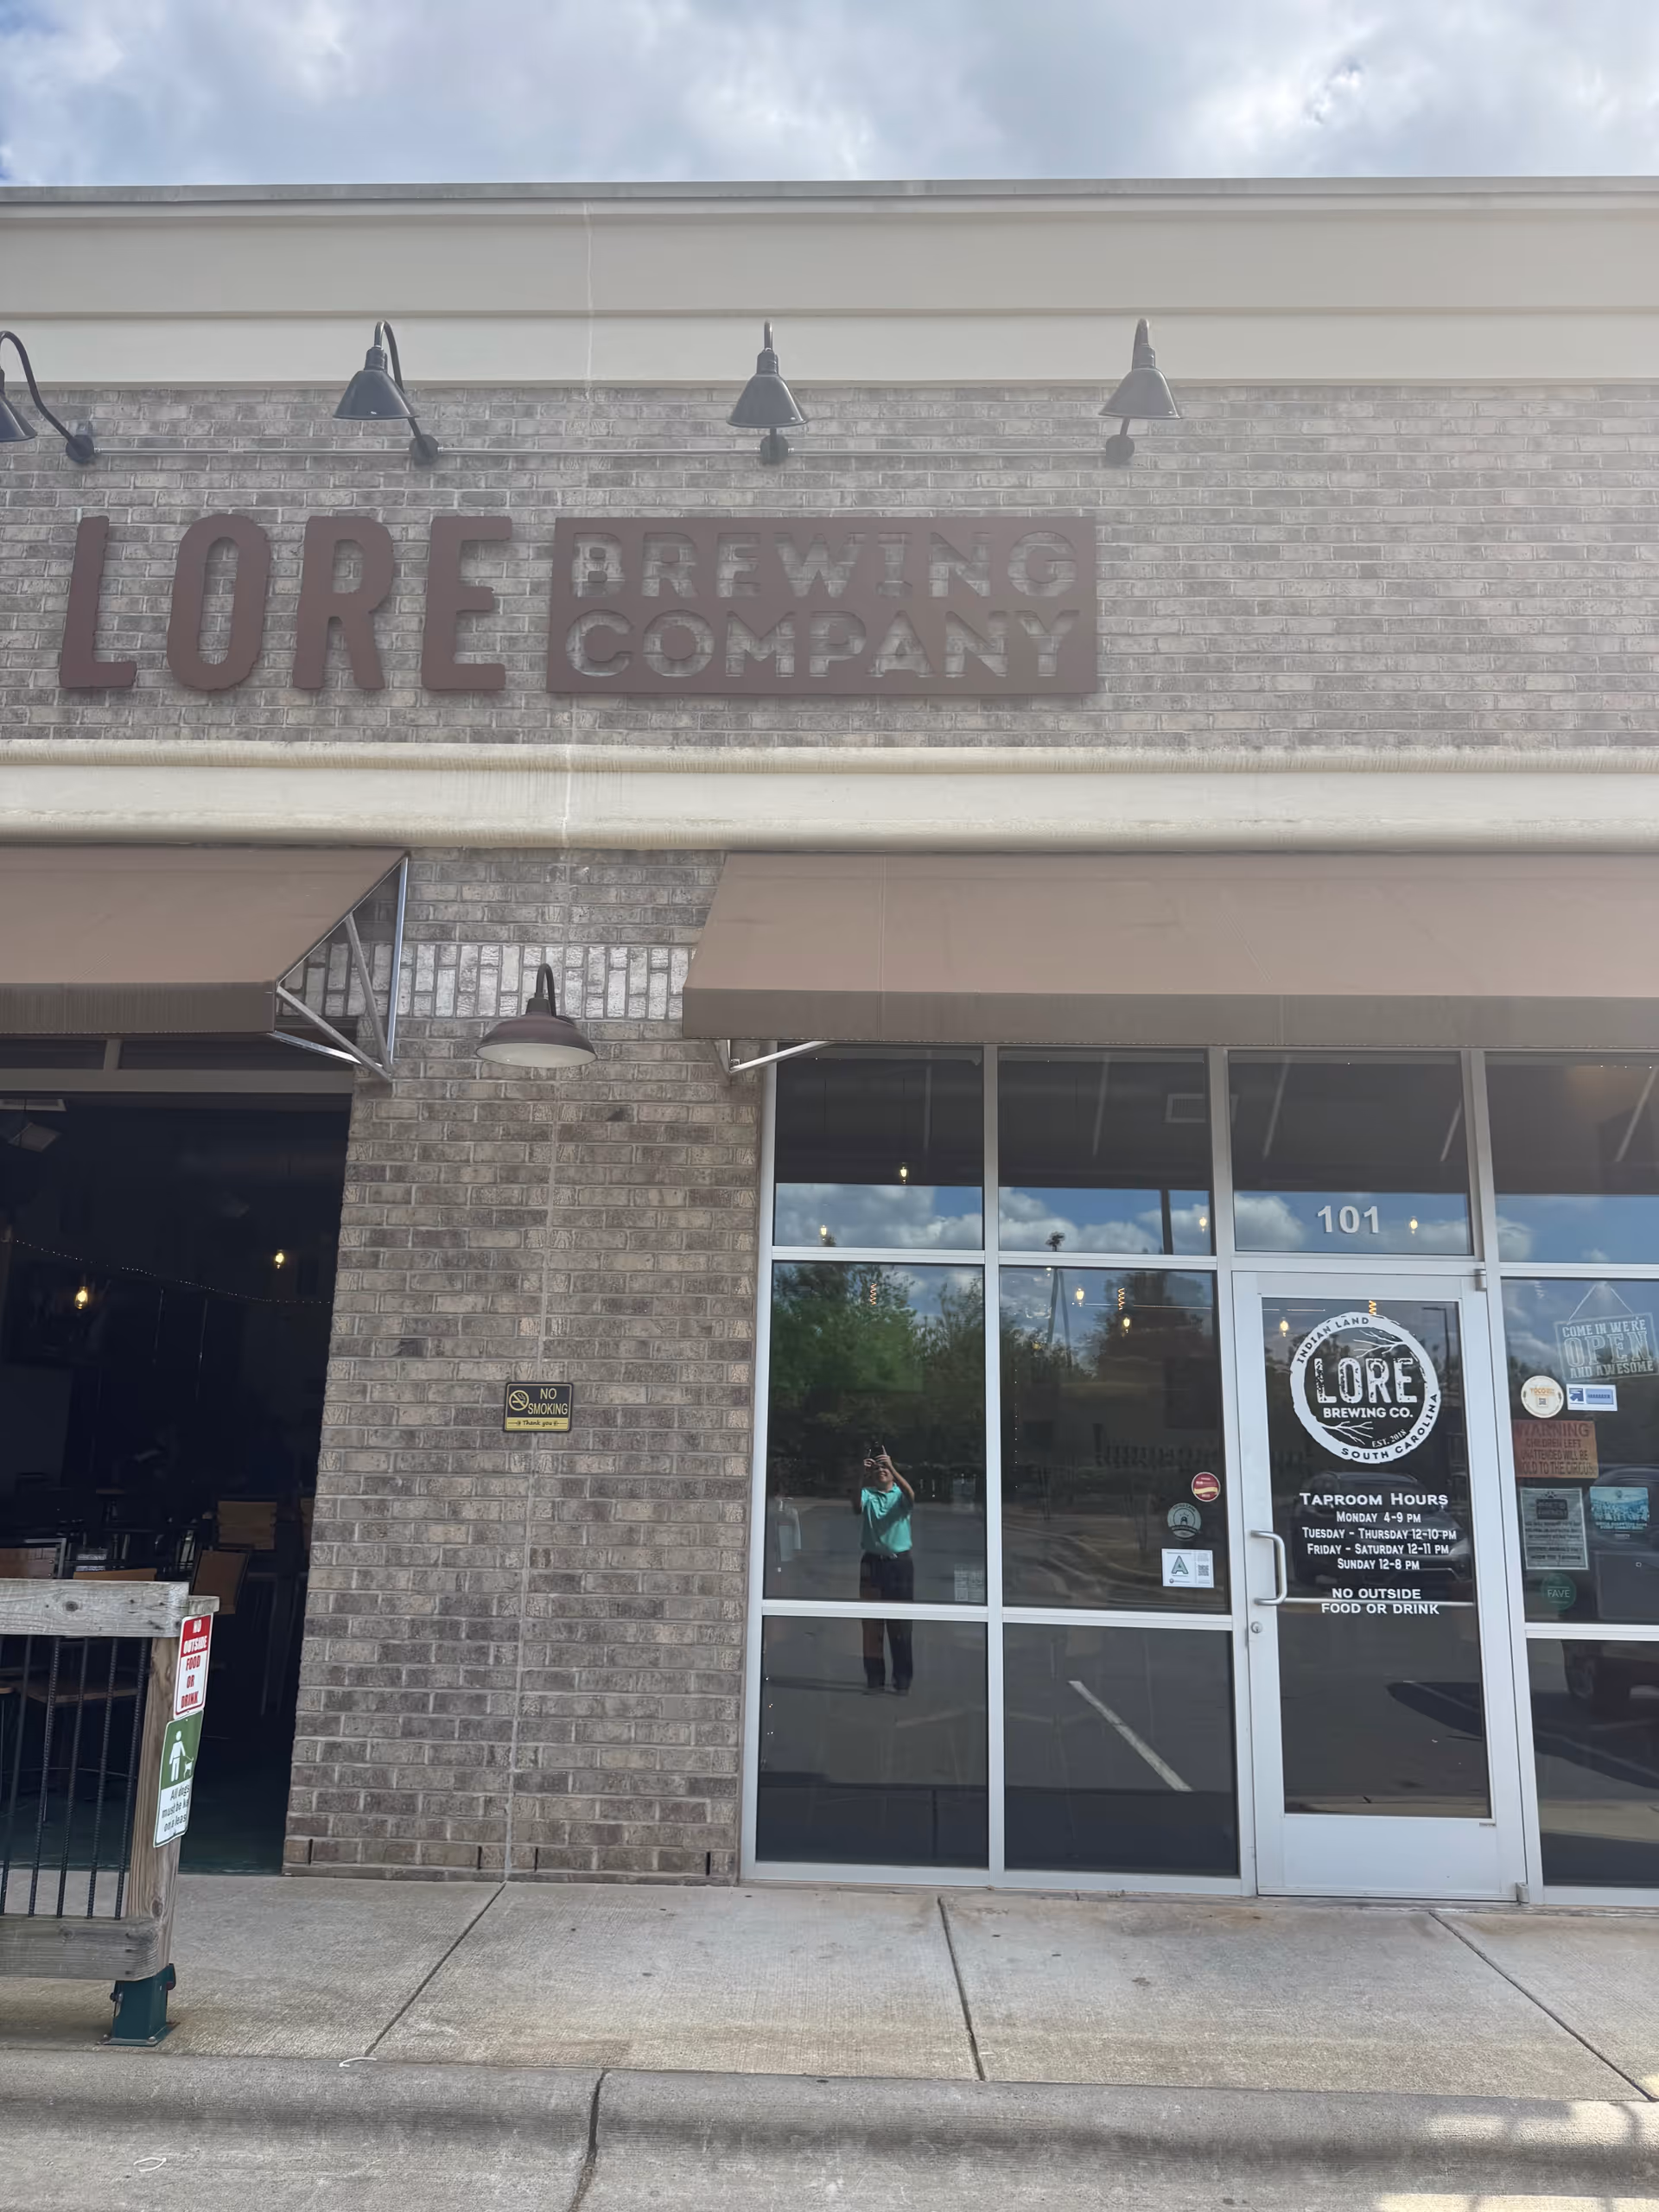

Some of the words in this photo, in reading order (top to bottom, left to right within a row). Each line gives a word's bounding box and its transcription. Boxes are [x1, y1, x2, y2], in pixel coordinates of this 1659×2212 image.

[570, 531, 1078, 599] BREWING
[59, 513, 512, 690] LORE
[564, 608, 1081, 678] COMPANY
[1317, 1205, 1379, 1233] 101
[1562, 1325, 1592, 1338] COME
[1595, 1323, 1606, 1334] IN
[1296, 1325, 1332, 1363] INDIAN
[1335, 1317, 1369, 1328] LAND
[1564, 1331, 1651, 1367] OPEN
[1570, 1366, 1592, 1378] AND
[1596, 1361, 1654, 1376] AWESOME
[1314, 1357, 1418, 1404] LORE
[540, 1388, 556, 1400] NO
[528, 1403, 568, 1414] SMOKING
[1323, 1407, 1386, 1418] BREWING
[1389, 1407, 1414, 1418] CO.
[1341, 1448, 1389, 1459] SOUTH
[1395, 1393, 1437, 1453] CAROLINA
[1372, 1439, 1389, 1447] EST.
[1390, 1429, 1407, 1442] 2018
[1564, 1439, 1582, 1448] LEFT
[1563, 1450, 1579, 1461] WILL
[1580, 1450, 1589, 1461] BE
[1517, 1461, 1537, 1475] OLD
[1539, 1462, 1549, 1475] TO
[1550, 1462, 1566, 1475] THE
[1300, 1493, 1382, 1505] TAPROOM
[1391, 1493, 1448, 1505] HOURS
[1337, 1511, 1377, 1522] MONDAY
[1383, 1512, 1403, 1522] 4-9
[1407, 1514, 1421, 1522] PM
[1302, 1527, 1344, 1539] TUESDAY
[1358, 1528, 1408, 1540] THURSDAY
[1412, 1529, 1439, 1540] 12-10
[1442, 1530, 1457, 1540] PM
[1307, 1543, 1341, 1554] FRIDAY
[1355, 1544, 1404, 1554] SATURDAY
[1408, 1544, 1431, 1554] 12-11
[1434, 1545, 1449, 1554] PM
[1172, 1555, 1189, 1574] A
[1338, 1559, 1376, 1569] SUNDAY
[1379, 1559, 1402, 1569] 12-8
[1405, 1560, 1420, 1570] PM
[1332, 1588, 1353, 1599] NO
[1358, 1589, 1421, 1599] OUTSIDE
[1321, 1604, 1361, 1613] FOOD
[1366, 1604, 1387, 1613] OR
[1393, 1604, 1440, 1614] DRINK
[193, 1619, 201, 1633] NO
[183, 1636, 207, 1654] OUTSIDE
[186, 1656, 200, 1670] FOOD
[187, 1675, 194, 1688] OR
[181, 1691, 199, 1708] DRINK
[170, 1787, 179, 1801] All
[178, 1783, 190, 1797] dogs
[162, 1802, 175, 1819] must
[175, 1801, 181, 1812] be
[163, 1821, 171, 1832] on
[175, 1813, 187, 1826] leas
